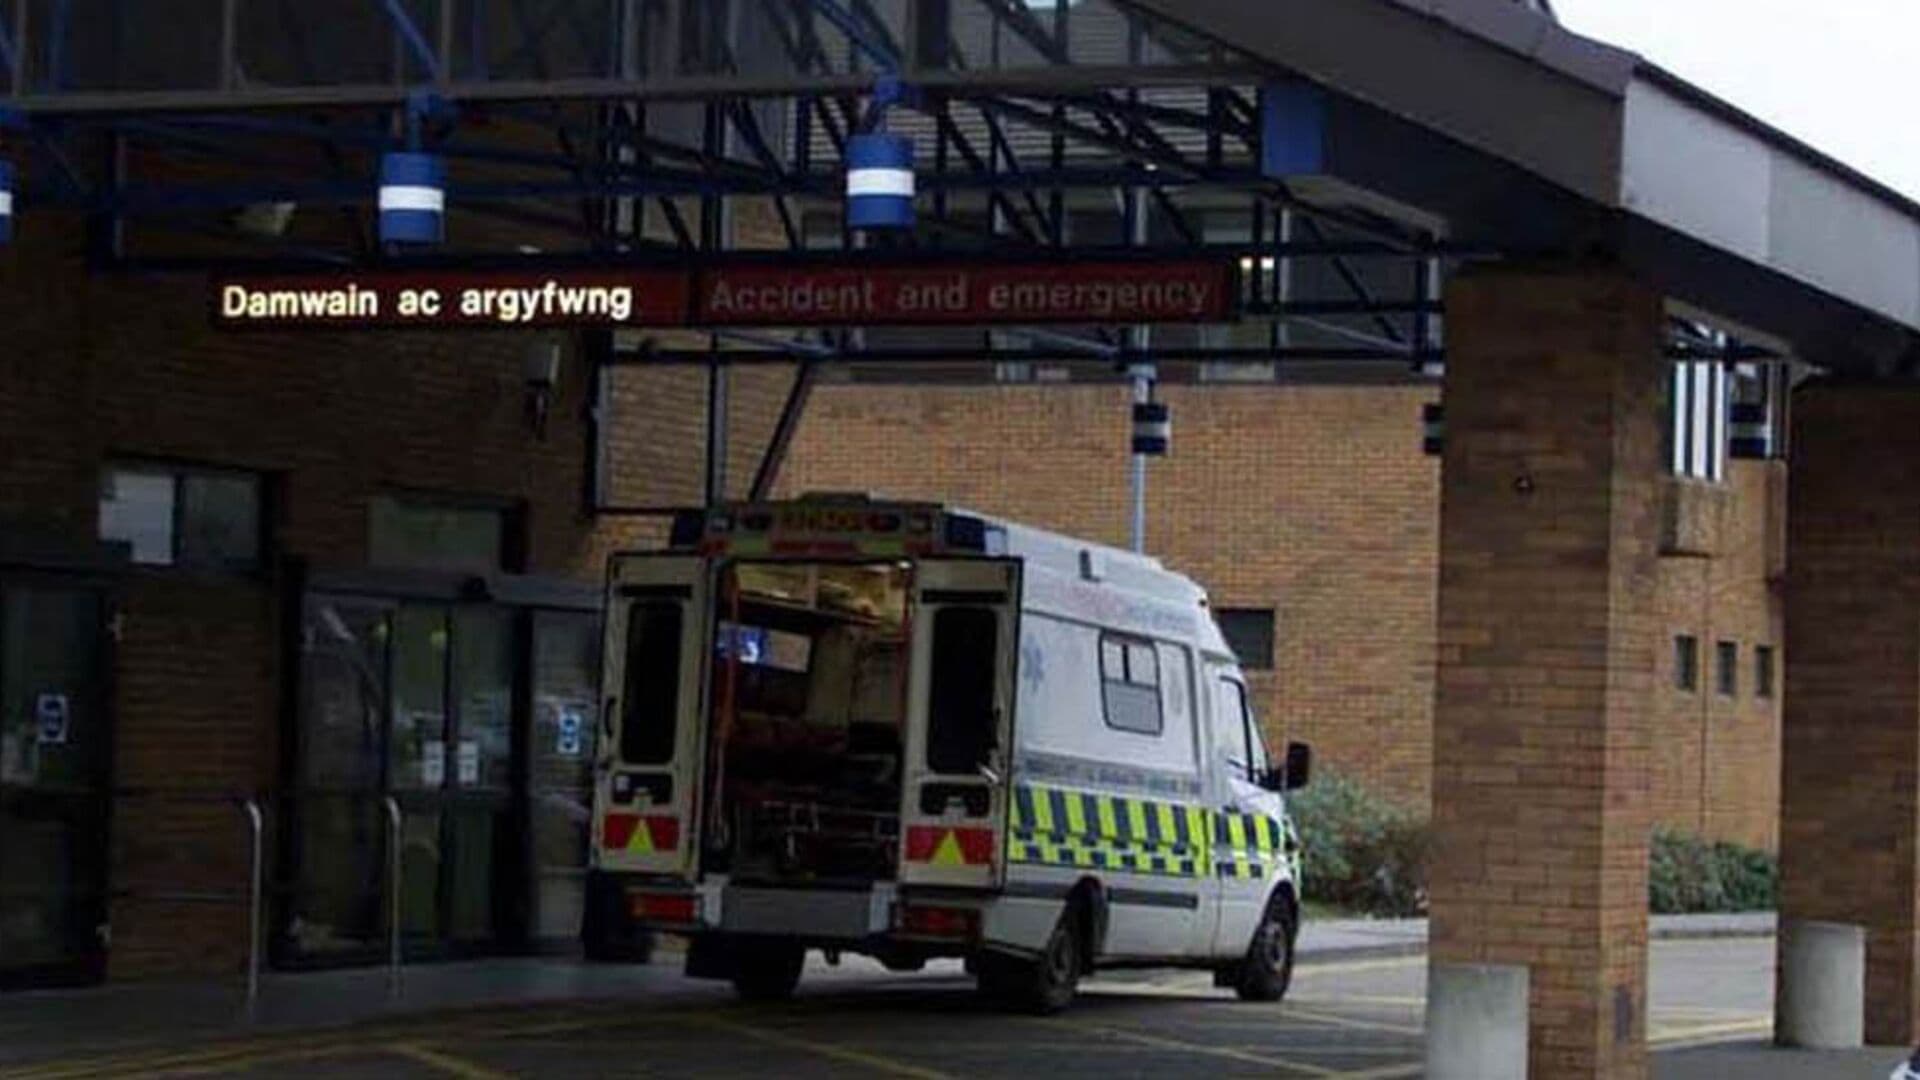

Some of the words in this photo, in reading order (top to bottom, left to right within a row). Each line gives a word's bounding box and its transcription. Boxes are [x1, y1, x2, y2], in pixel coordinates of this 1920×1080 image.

[222, 283, 378, 318] Damwain
[397, 289, 441, 316] ac
[460, 282, 633, 322] argyfwng
[710, 278, 874, 313] Accident
[898, 278, 968, 311] and
[988, 279, 1211, 316] emergency
